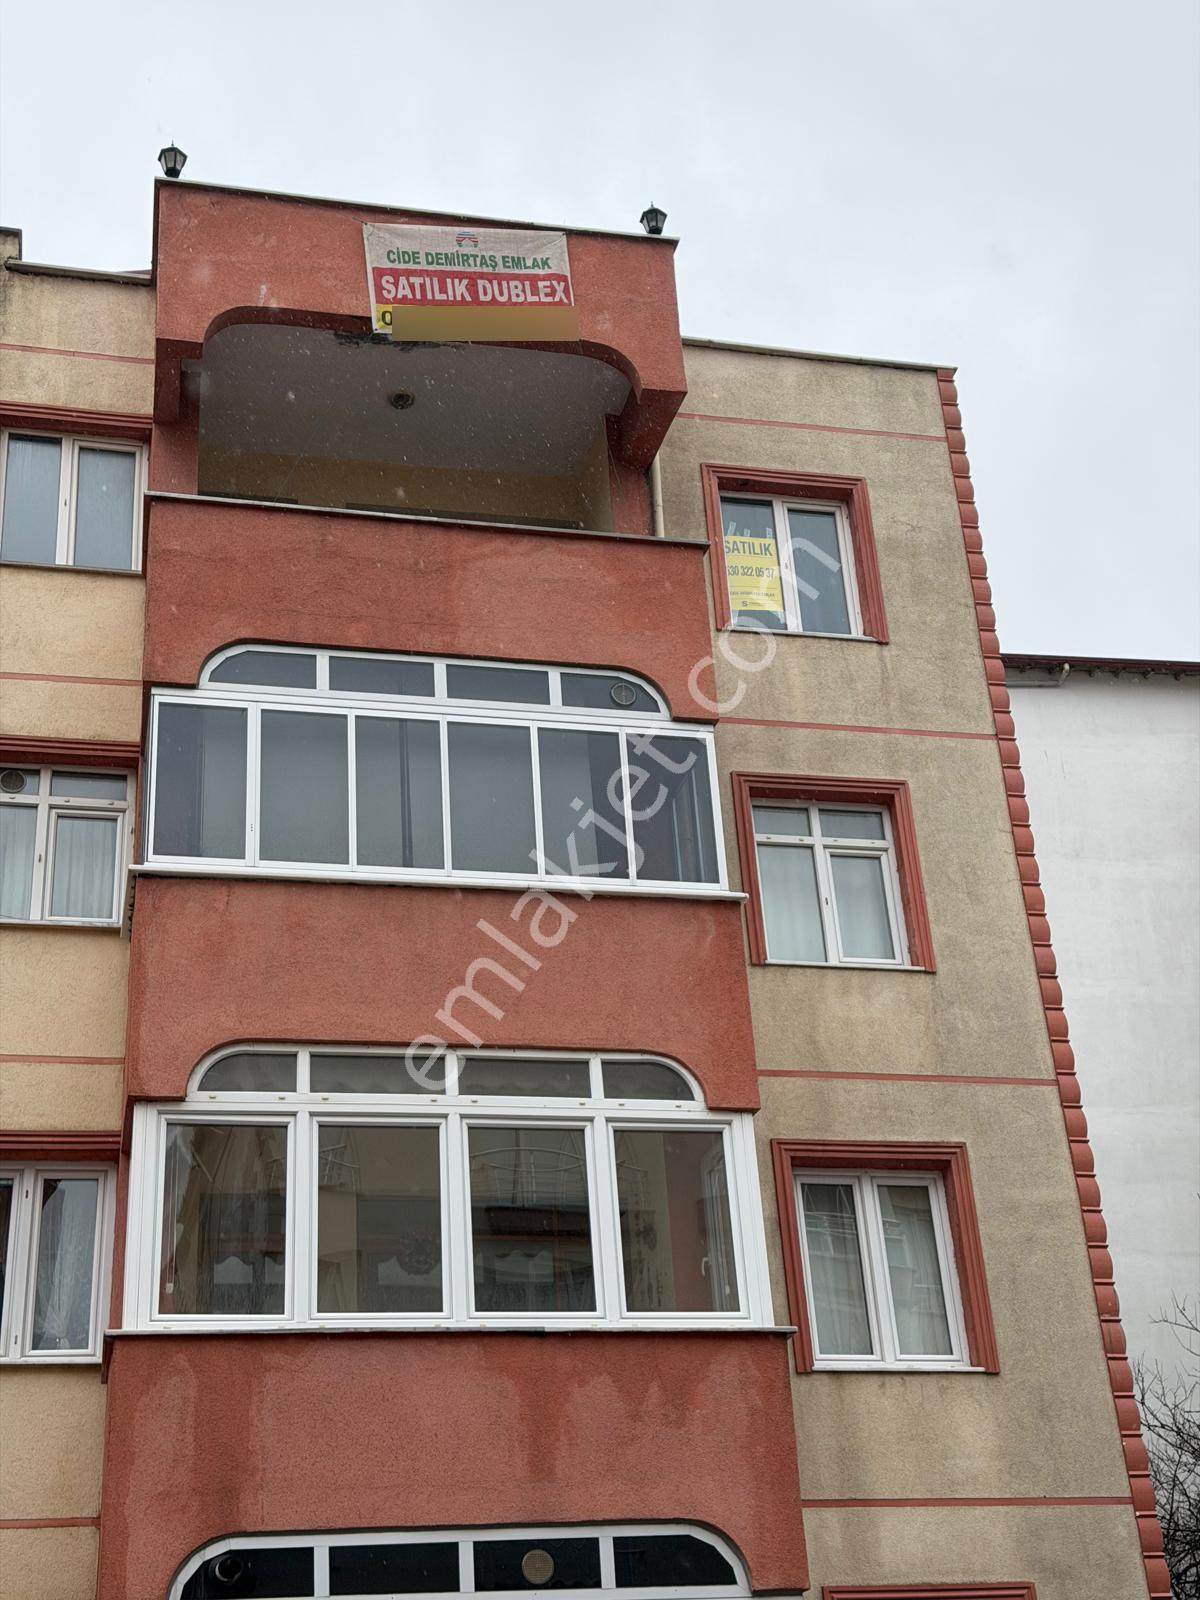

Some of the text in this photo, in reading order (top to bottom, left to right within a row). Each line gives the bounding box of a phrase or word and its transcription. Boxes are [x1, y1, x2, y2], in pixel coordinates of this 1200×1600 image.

[386, 247, 552, 271] CİDE DEMİRTAŞ EMLAK
[381, 275, 568, 304] SATILIK DUBLEX
[725, 541, 773, 556] SATILIK
